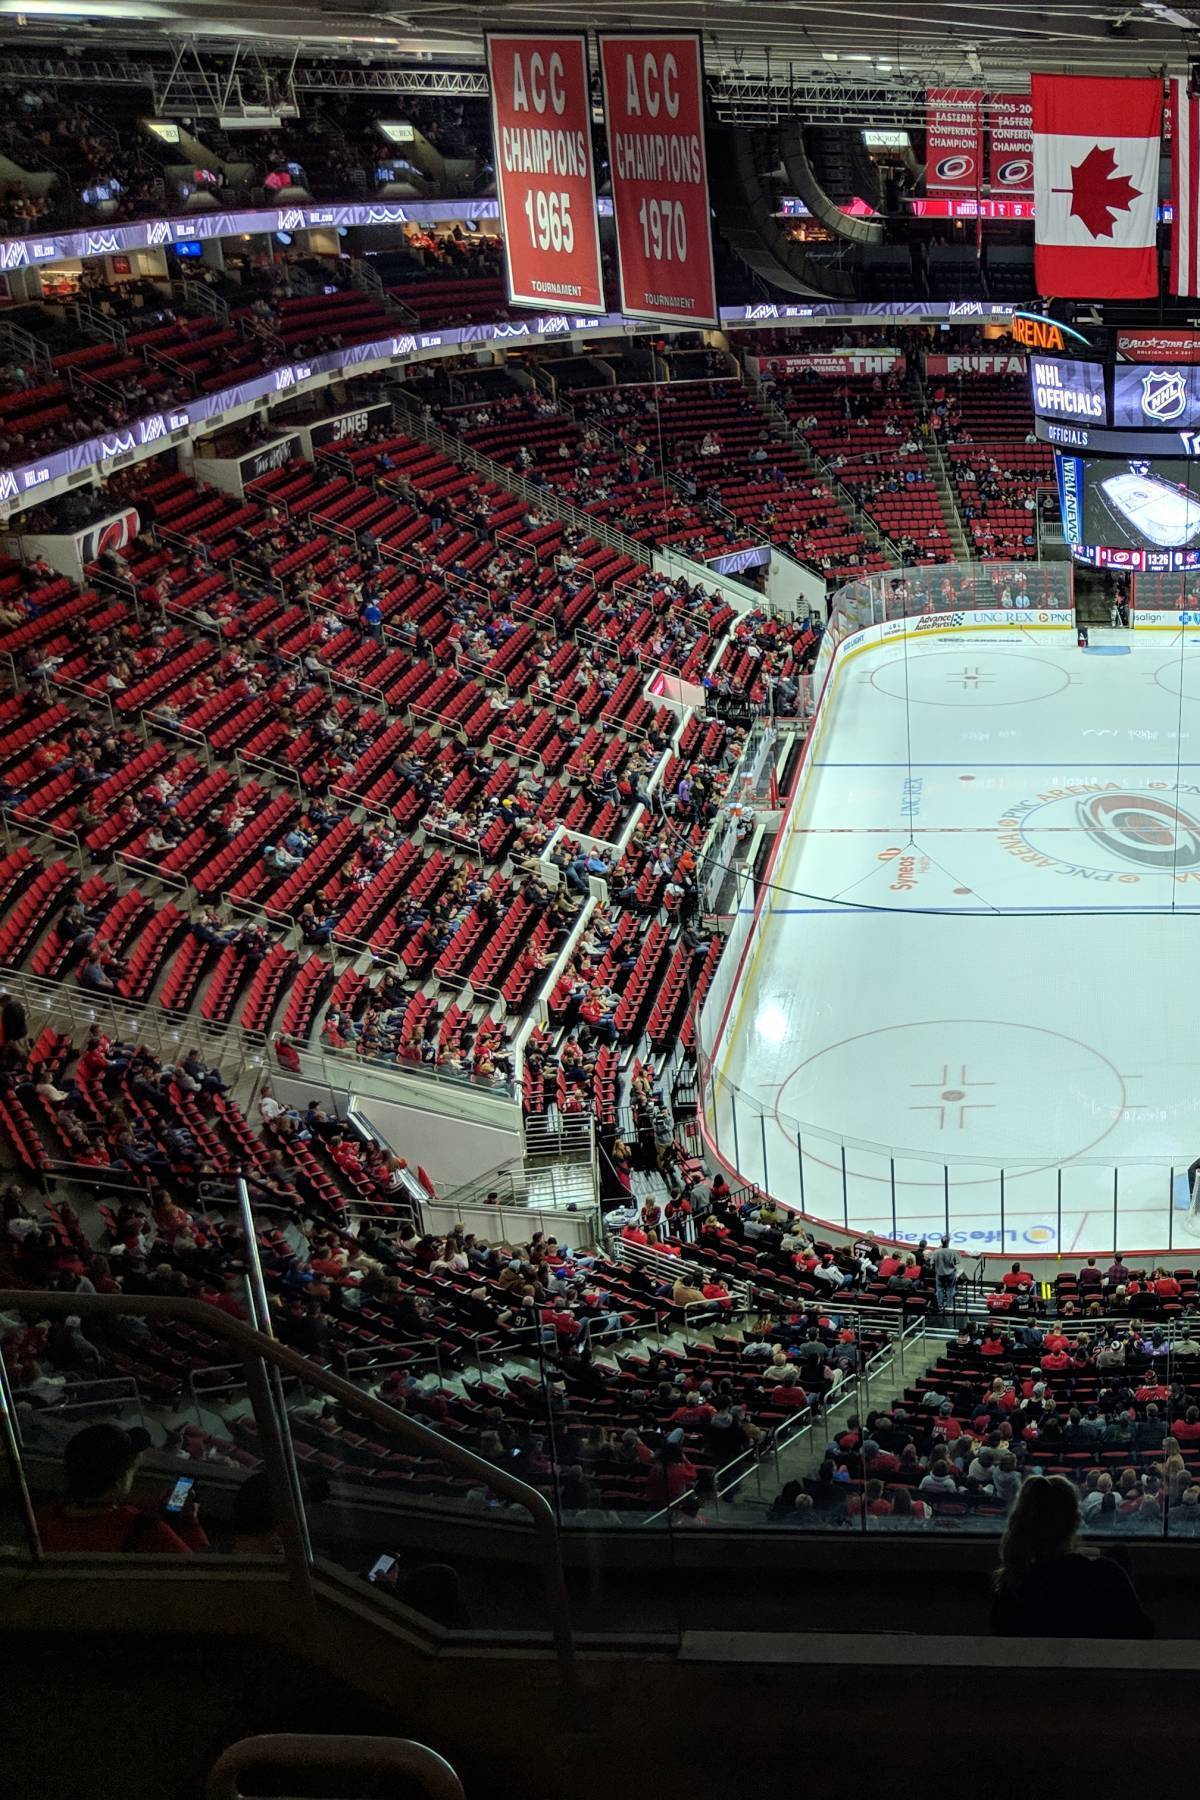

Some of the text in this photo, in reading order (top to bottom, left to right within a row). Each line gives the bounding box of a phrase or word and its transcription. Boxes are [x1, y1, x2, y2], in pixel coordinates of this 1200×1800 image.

[514, 52, 566, 114] ACC
[626, 52, 680, 118] ACC
[930, 126, 976, 136] CONFERENC
[992, 129, 1034, 139] CONFEREN
[502, 126, 586, 178] CHAMPIONS
[930, 138, 977, 149] CHAMPION
[992, 142, 1034, 152] CHAMPIO
[616, 132, 701, 184] CHAMPIONS
[525, 190, 574, 254] 1965
[640, 198, 686, 262] 1970
[532, 280, 582, 297] TOURNAMENT
[644, 293, 696, 309] TOURNAMENT
[992, 306, 1012, 314] NHL.co
[1012, 319, 1064, 350] ARENA
[850, 356, 1026, 373] THE BUFFA
[1035, 364, 1062, 387] NHL
[1038, 387, 1102, 417] OFFICIALS
[1151, 382, 1178, 410] NHL
[333, 412, 368, 440] CANES
[1048, 426, 1088, 446] OFFICIALS
[1132, 552, 1140, 565] 0
[1148, 554, 1168, 566] 13:26
[1174, 552, 1183, 566] 0
[918, 614, 951, 624] Advance
[974, 612, 1032, 622] UNC REX
[1050, 614, 1072, 622] PNC
[1011, 782, 1122, 819] PNC ARENA
[997, 832, 1112, 882] PNC ARENA
[890, 856, 919, 890] Syneos
